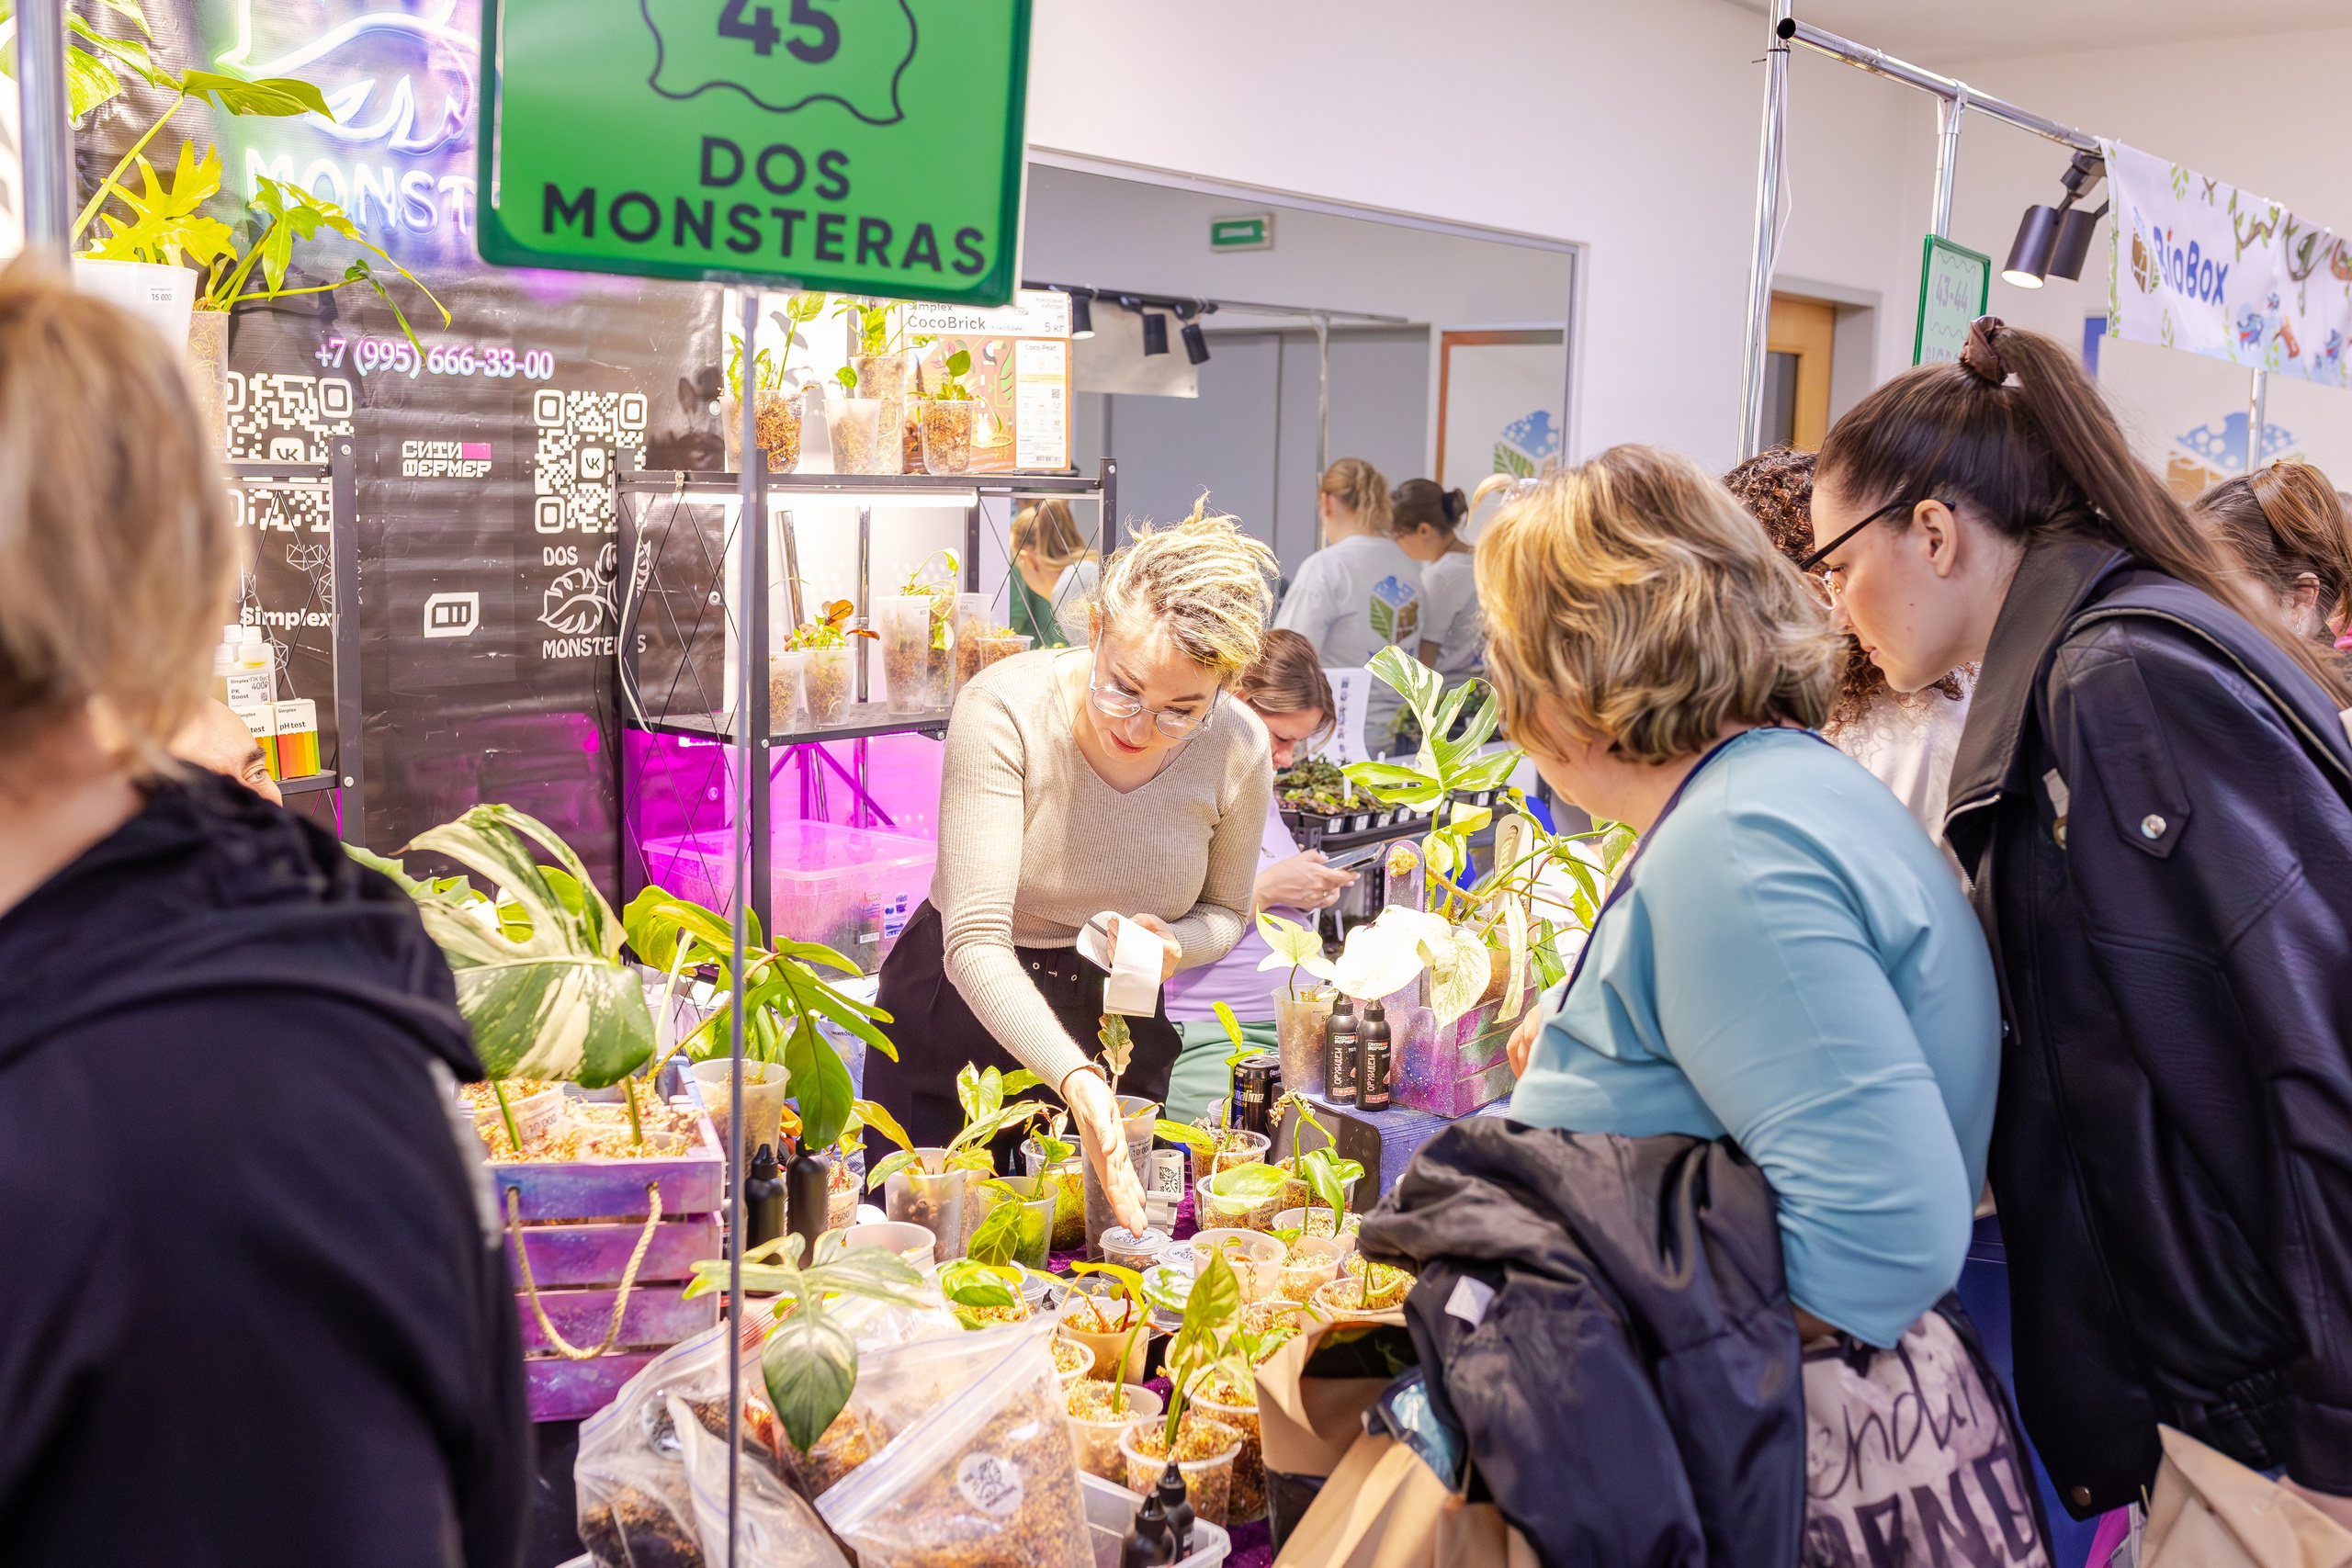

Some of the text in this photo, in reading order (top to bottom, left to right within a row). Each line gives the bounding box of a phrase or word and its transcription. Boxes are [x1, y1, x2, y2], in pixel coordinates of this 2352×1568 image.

[717, 0, 841, 63] 45
[699, 134, 851, 201] DOS
[541, 182, 987, 276] MONSTERAS
[2153, 226, 2229, 307] BioBox
[152, 293, 173, 301] 15 000
[1935, 274, 1969, 313] 43-44
[908, 315, 987, 331] CocoBrick
[1045, 321, 1051, 333] 5
[315, 336, 556, 380] +7 (995) 666-33-00
[401, 440, 463, 459] СИТИ
[542, 545, 579, 567] DOS
[240, 607, 332, 629] Simplex
[541, 634, 648, 660] MONSTES
[250, 725, 266, 734] test
[279, 721, 307, 731] pH test
[1366, 1054, 1376, 1092] ОРХИДЕИ
[837, 1210, 850, 1223] 500
[1259, 1214, 1272, 1224] 800
